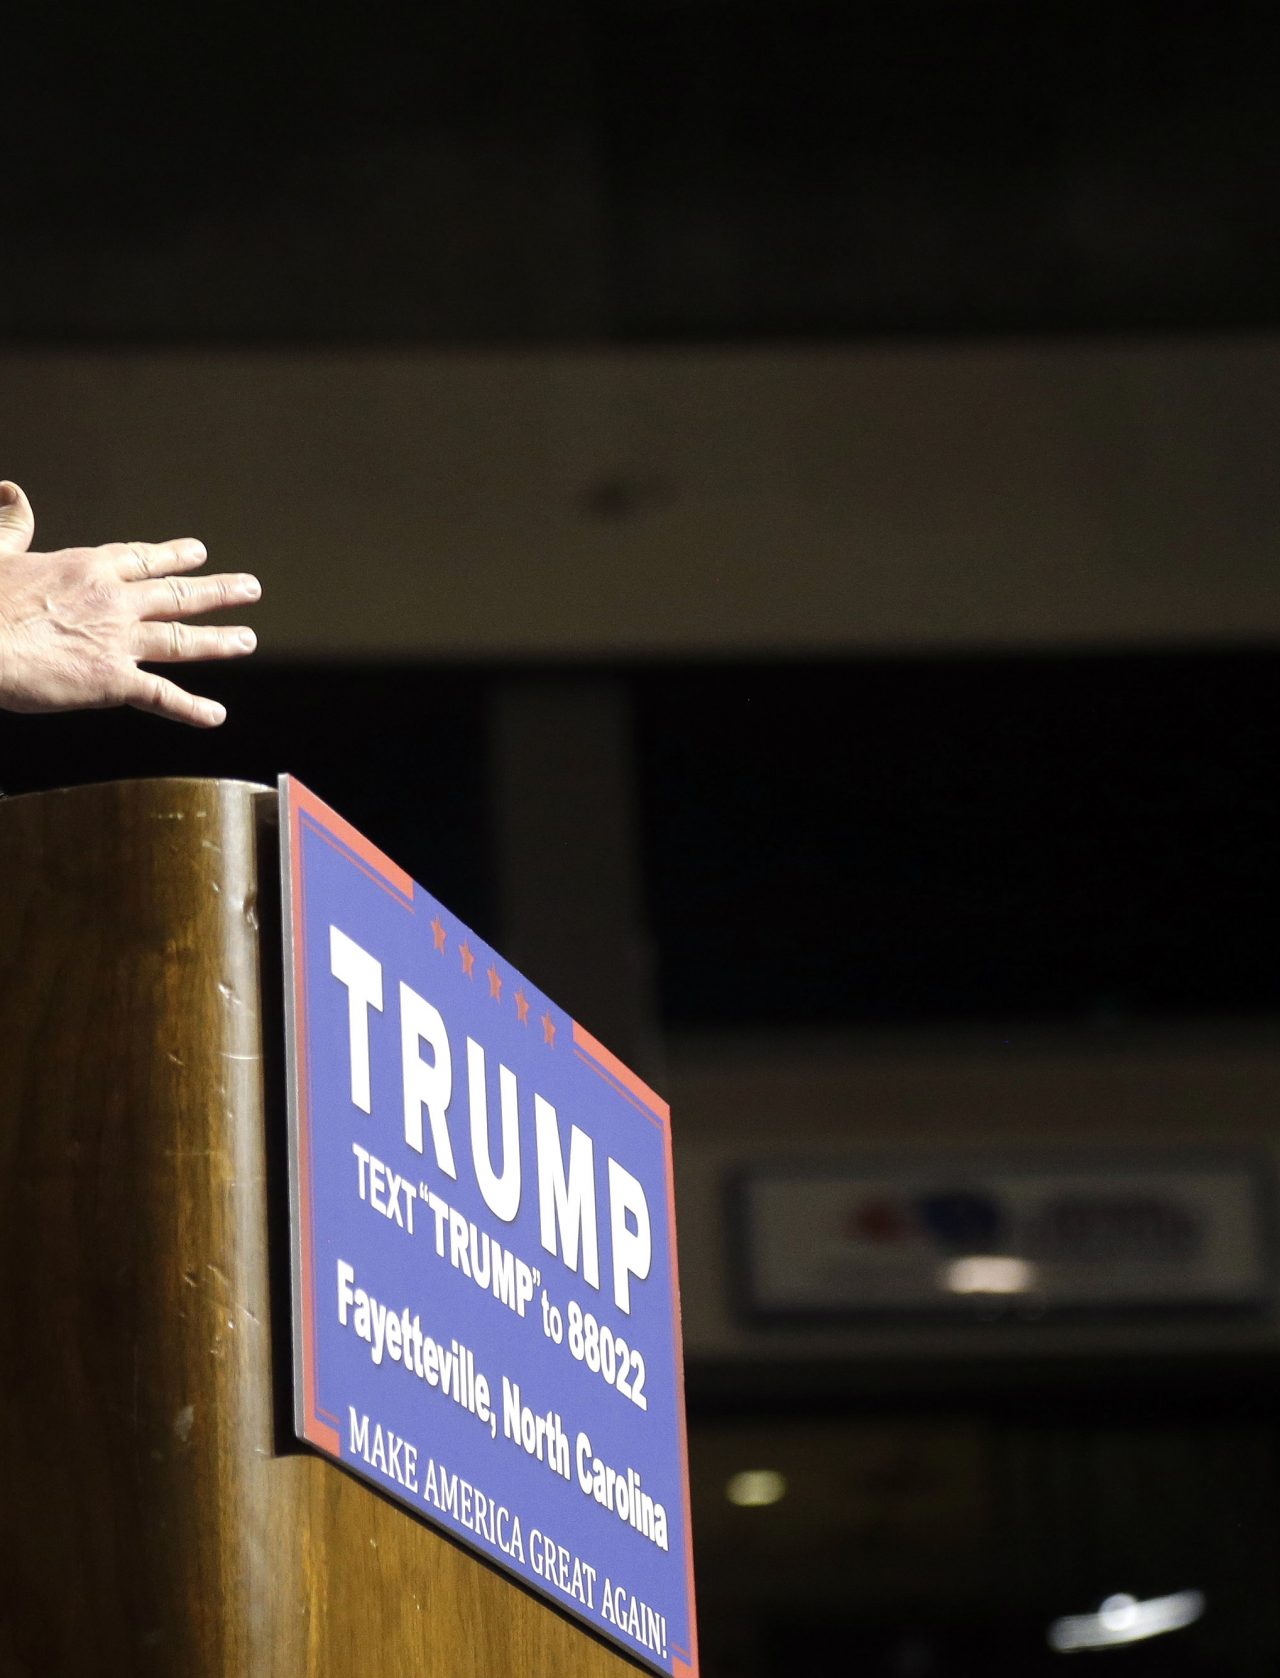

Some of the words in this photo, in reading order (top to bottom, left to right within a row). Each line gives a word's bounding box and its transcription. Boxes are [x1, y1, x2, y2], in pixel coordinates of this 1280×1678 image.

[329, 923, 652, 1315] TRUMP
[336, 1258, 497, 1439] Fayetteville,
[502, 1375, 571, 1481] North
[575, 1431, 669, 1552] Carolina
[351, 1141, 417, 1235] TEXT
[418, 1180, 541, 1318] “TRUMP”
[540, 1288, 563, 1345] to
[567, 1300, 648, 1411] 88022
[348, 1405, 419, 1494] MAKE
[422, 1458, 526, 1565] AMERICA
[528, 1528, 597, 1610] GREAT
[600, 1577, 668, 1659] AGAIN!
